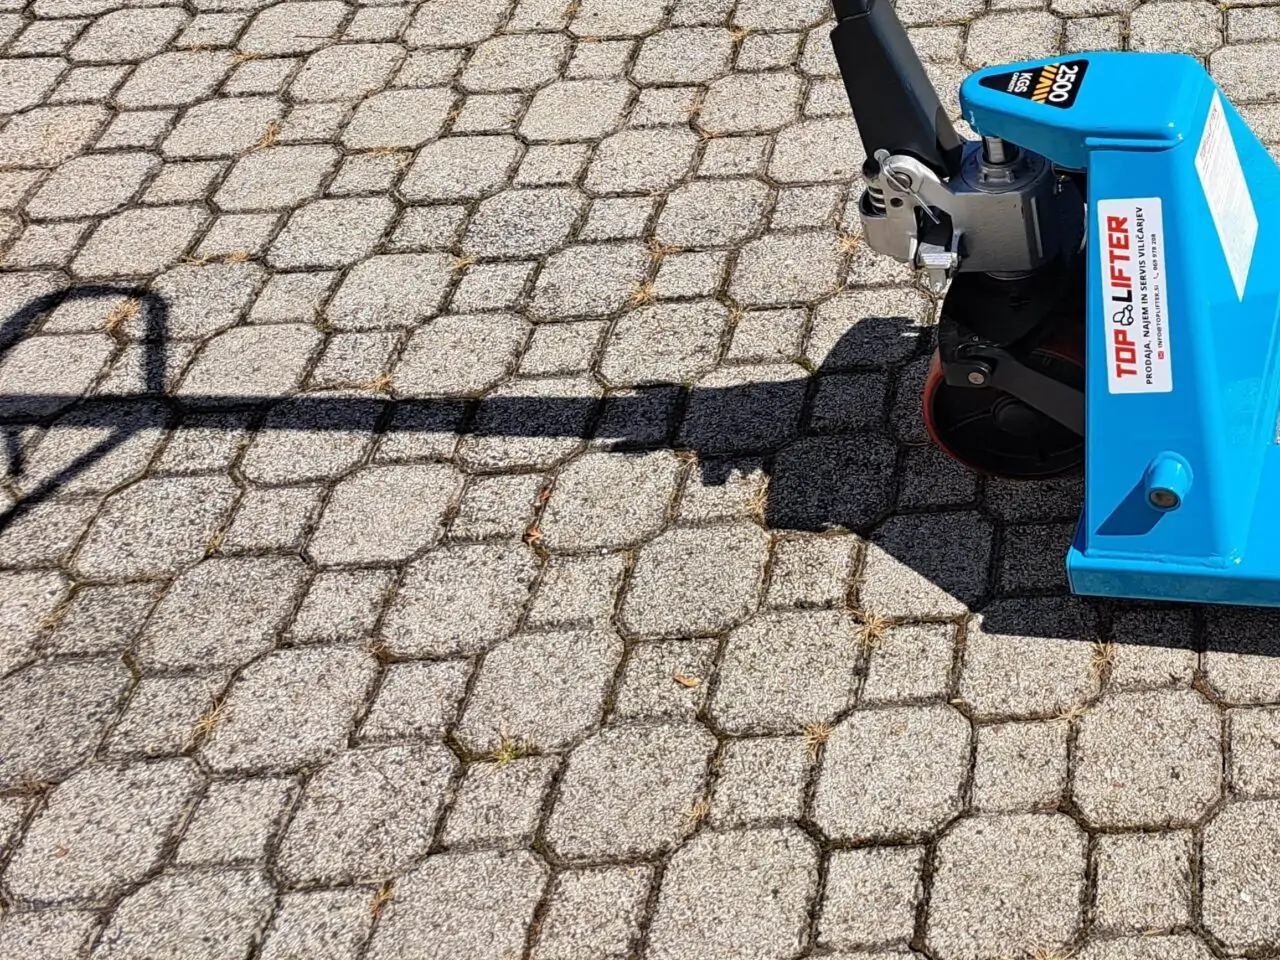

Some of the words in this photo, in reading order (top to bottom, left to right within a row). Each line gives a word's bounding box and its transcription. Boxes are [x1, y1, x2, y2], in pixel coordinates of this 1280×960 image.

[1014, 72, 1033, 93] KGS
[1048, 65, 1078, 101] 2500
[1136, 207, 1145, 258] VILIČARJEV
[1107, 216, 1132, 302] LIFTER
[1139, 260, 1147, 291] SERVIS
[1141, 293, 1149, 304] IN
[1154, 285, 1162, 348] INFO@TOPLIFTER.SI
[1141, 306, 1151, 338] NAJEM
[1113, 329, 1138, 378] TOP
[1143, 340, 1154, 385] PRODAJA,
